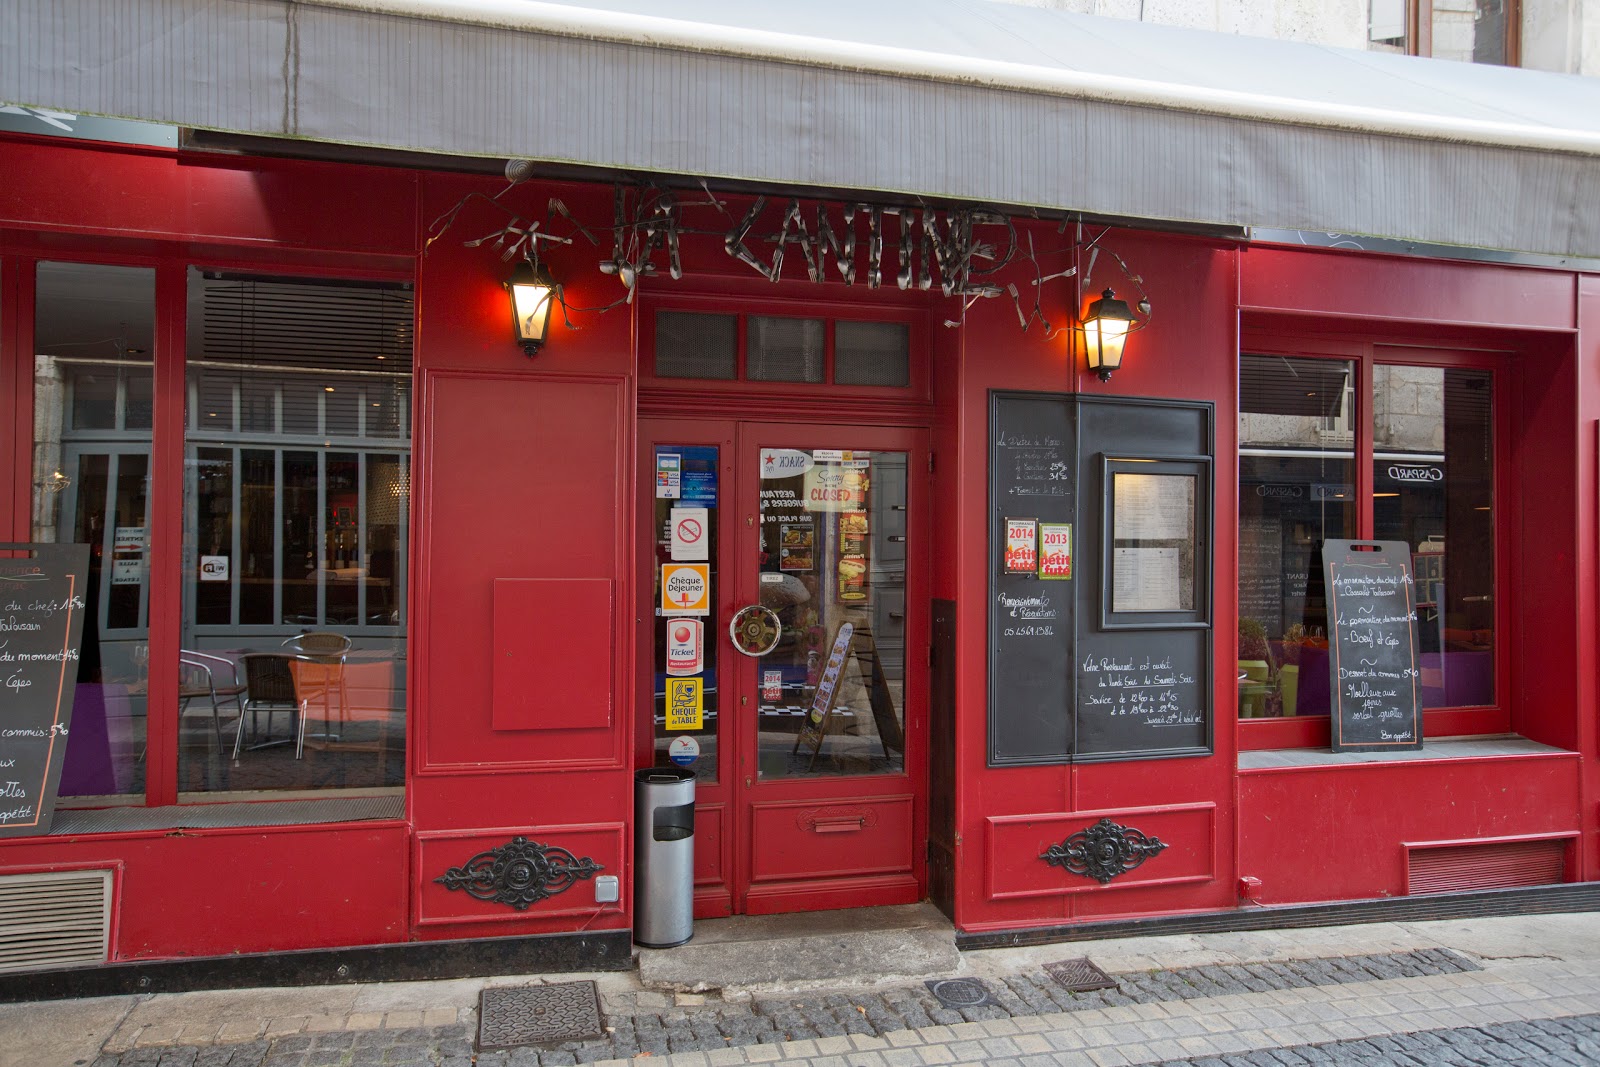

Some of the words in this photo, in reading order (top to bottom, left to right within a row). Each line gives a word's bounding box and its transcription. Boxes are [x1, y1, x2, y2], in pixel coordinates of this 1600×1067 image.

[810, 488, 851, 502] CLOSED
[1009, 528, 1034, 539] 2014
[1044, 533, 1067, 544] 2013
[1004, 549, 1037, 562] petit
[1039, 554, 1071, 568] petit
[1010, 559, 1037, 571] futé
[1044, 564, 1071, 577] futé
[670, 577, 701, 586] Chèque
[4, 600, 22, 611] du
[18, 648, 63, 662] moment
[670, 648, 694, 656] Ticket
[677, 716, 697, 724] TABLE
